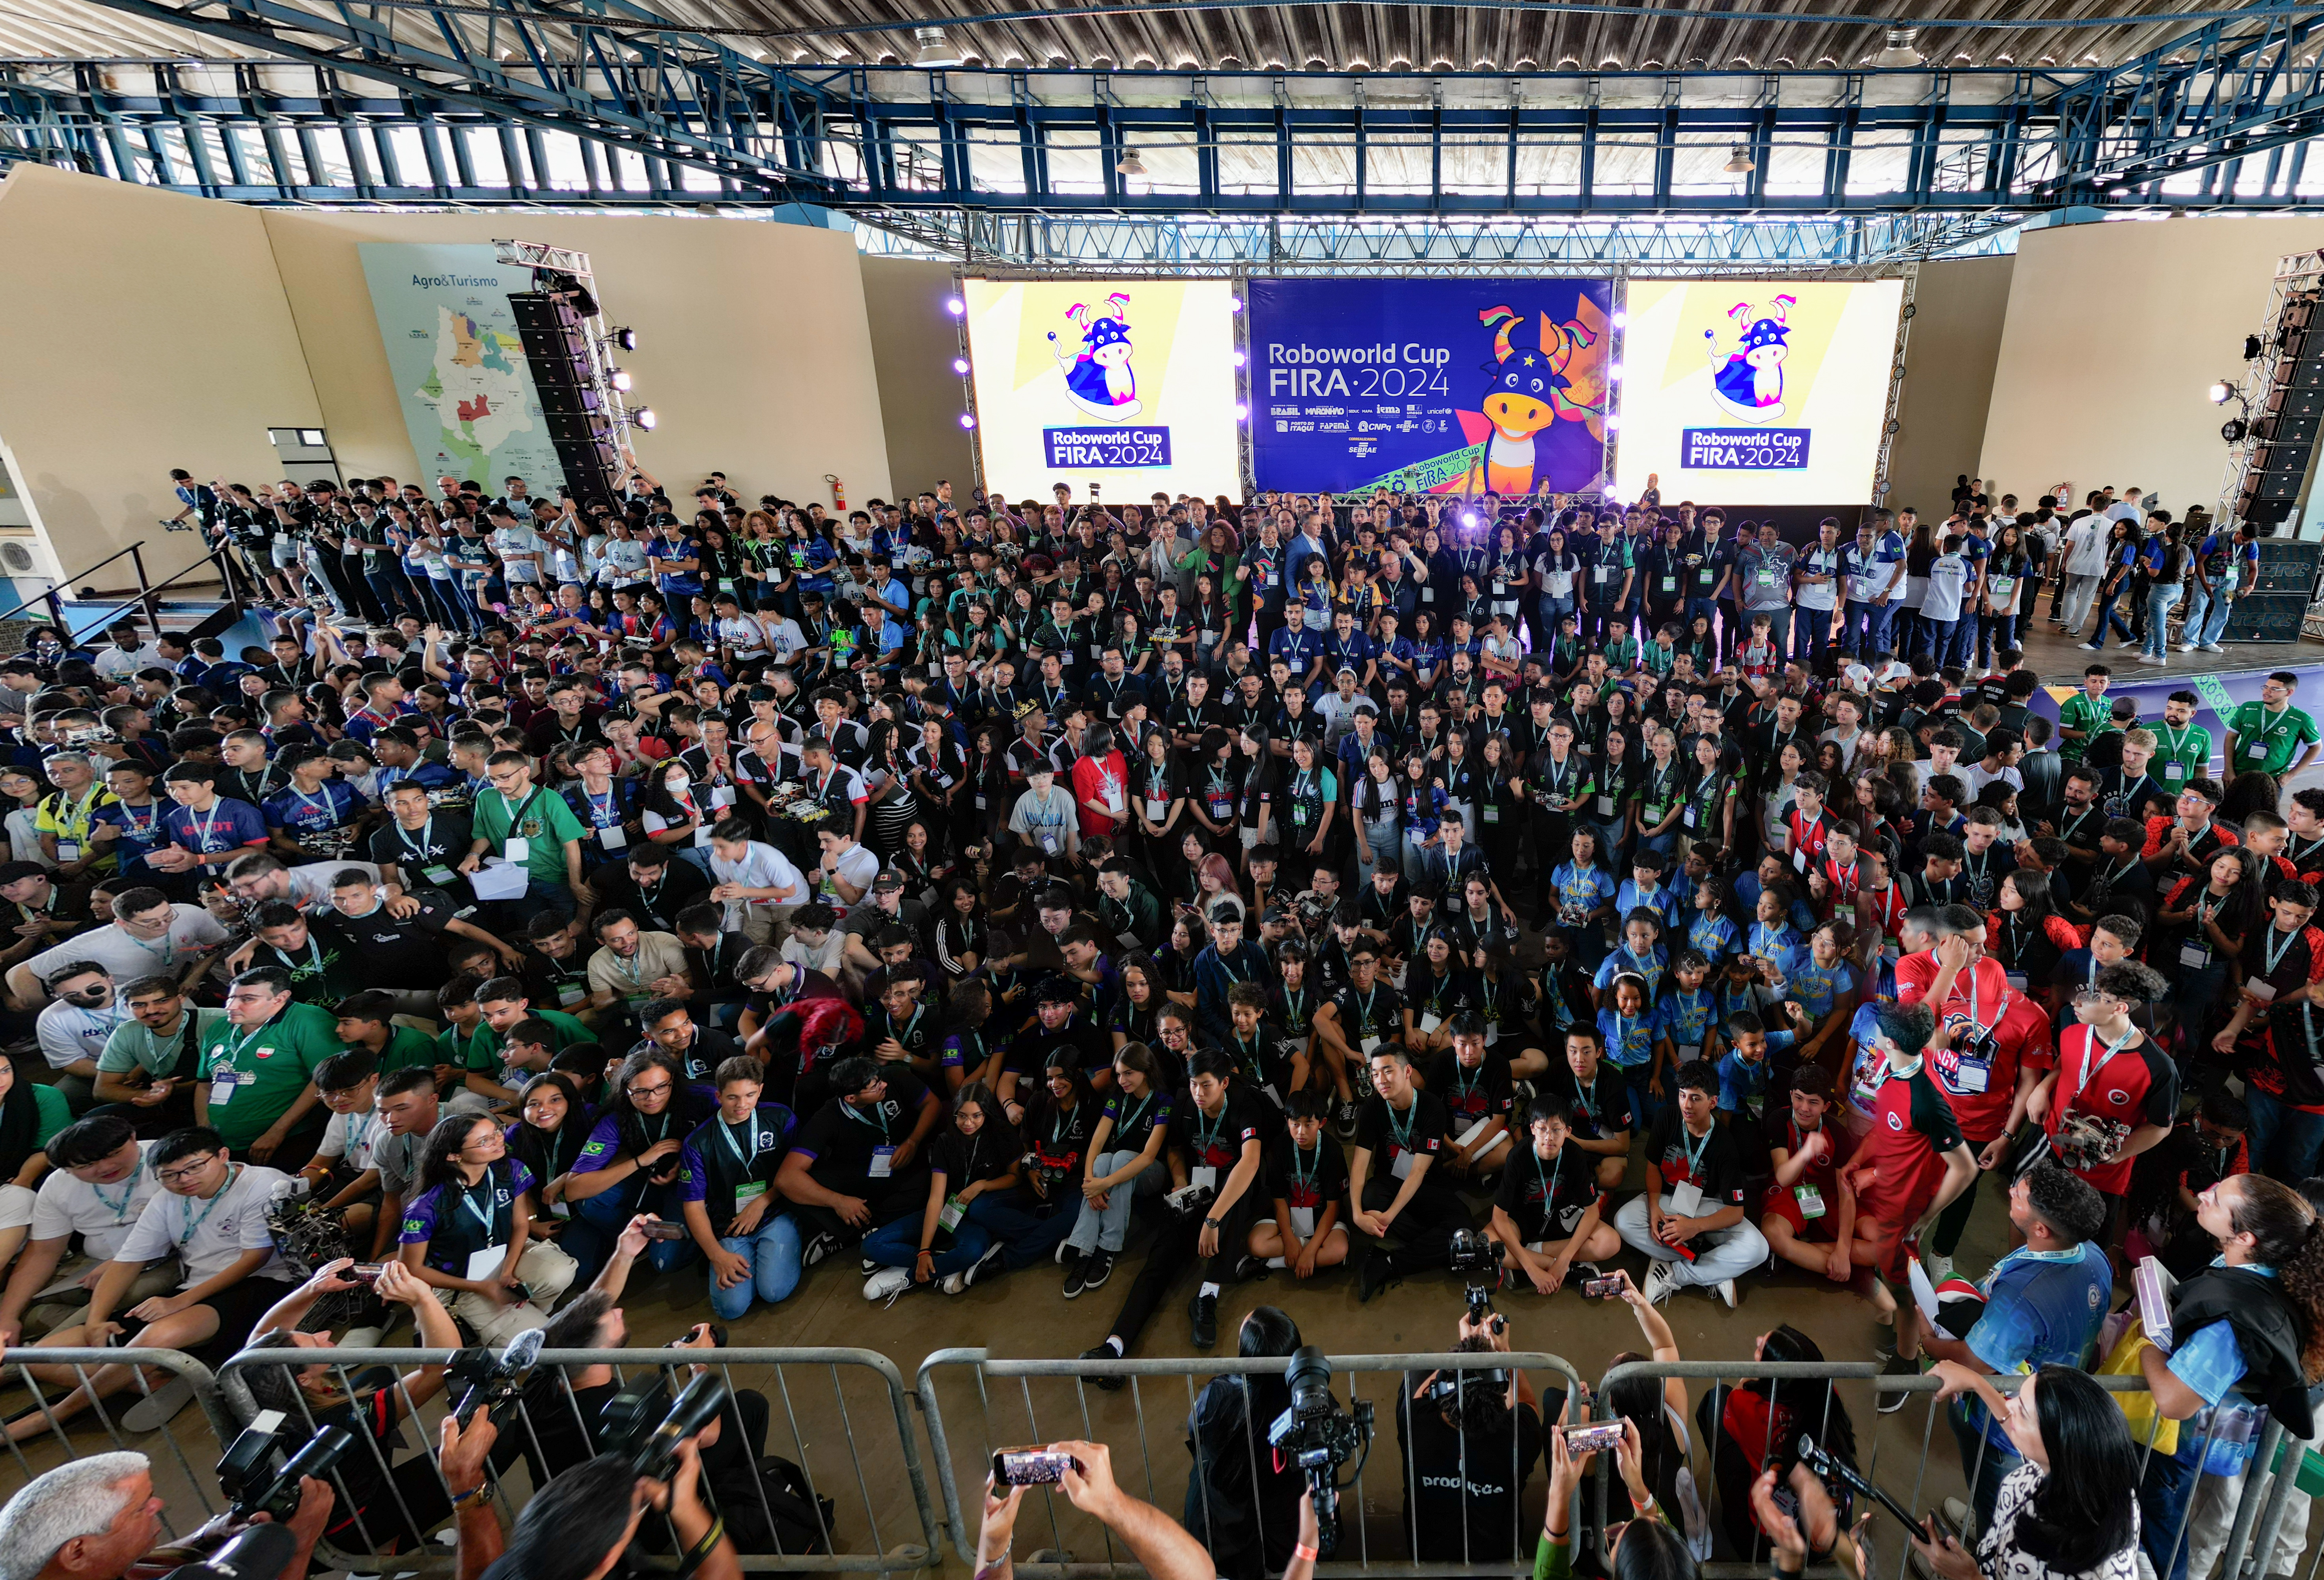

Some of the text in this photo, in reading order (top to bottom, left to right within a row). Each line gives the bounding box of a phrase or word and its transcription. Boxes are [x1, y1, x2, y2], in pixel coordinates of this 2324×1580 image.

[412, 275, 498, 289] Agro&Turismo
[1269, 343, 1450, 368] Roboworld Cup
[1369, 423, 1392, 432] CNPq
[1053, 431, 1162, 447] Roboworld Cup
[1692, 432, 1802, 449] Roboworld Cup
[1462, 446, 1479, 457] Cup
[1701, 800, 1712, 827] IFMA
